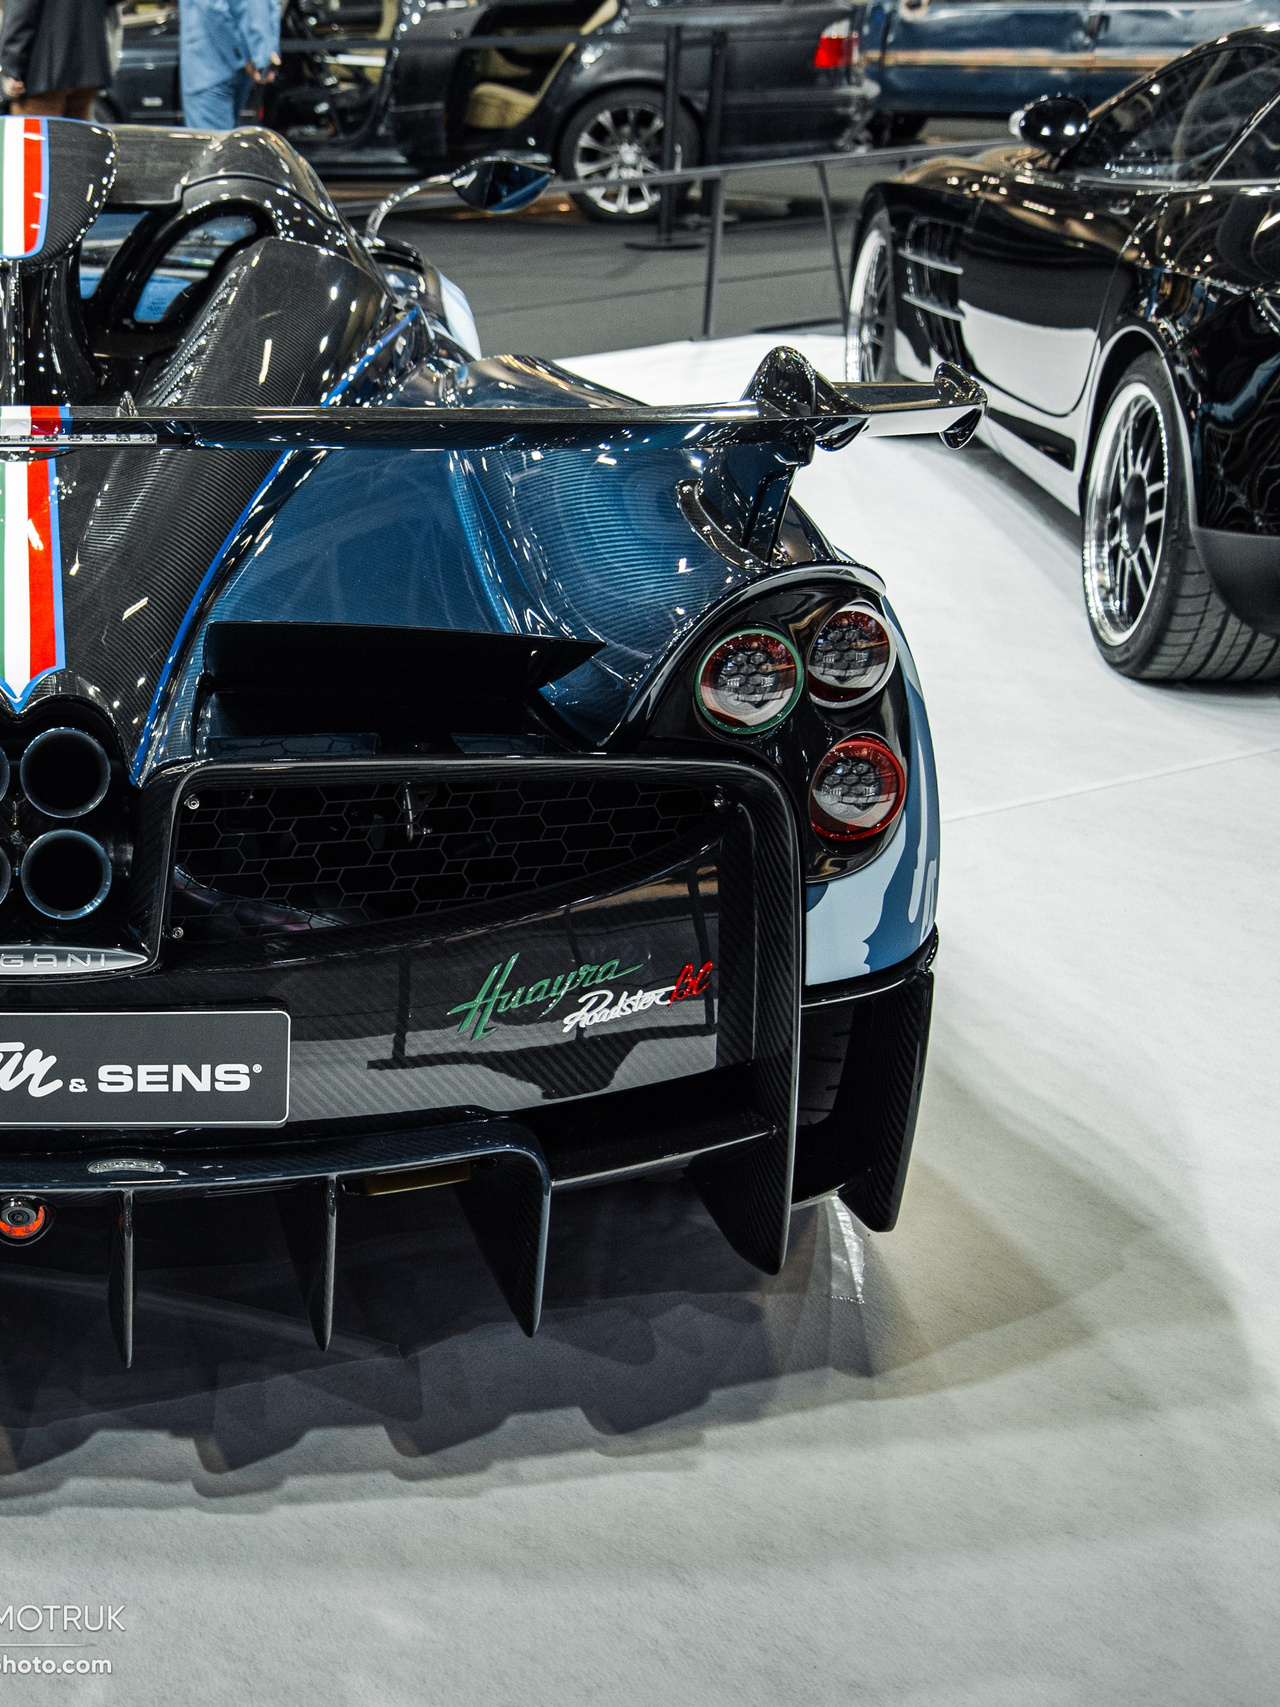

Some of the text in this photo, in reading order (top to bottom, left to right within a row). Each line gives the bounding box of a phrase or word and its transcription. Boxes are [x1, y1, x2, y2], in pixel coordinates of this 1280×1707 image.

[447, 952, 645, 1041] Huayra
[562, 985, 676, 1033] Roadster
[69, 1078, 88, 1093] &
